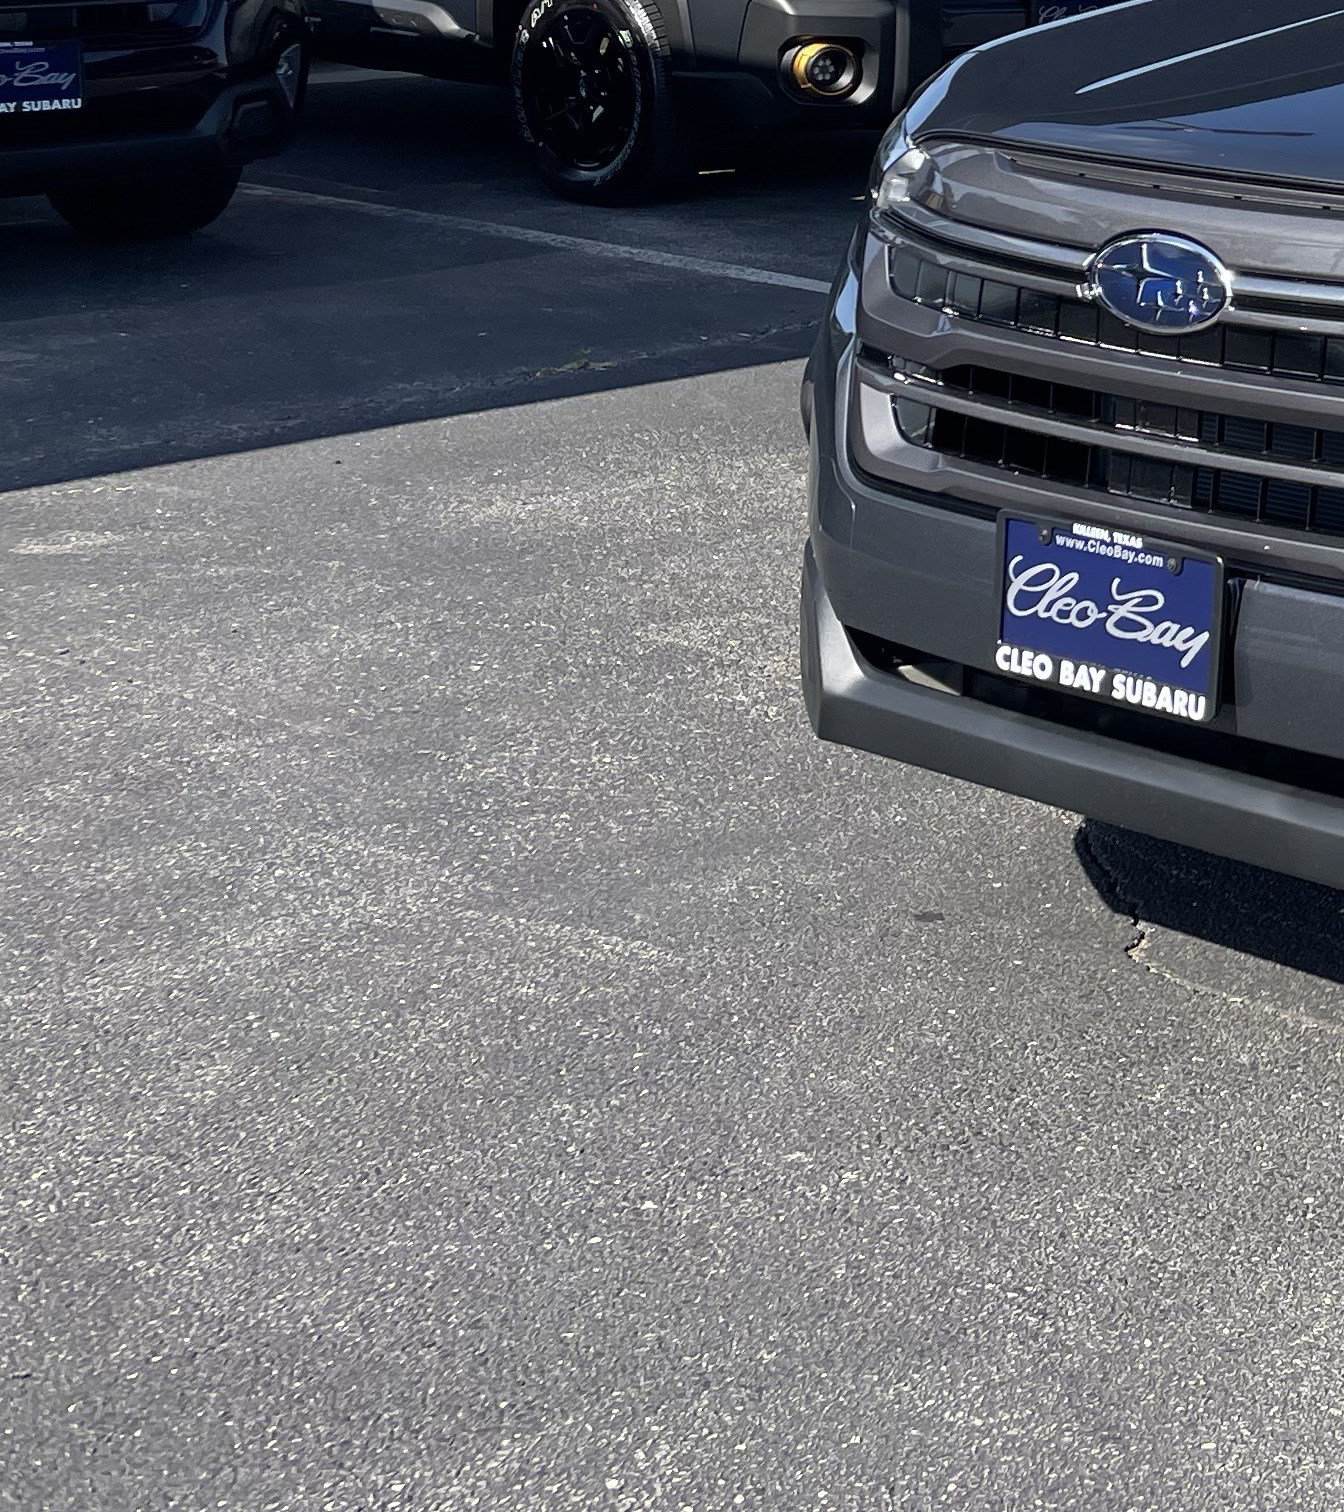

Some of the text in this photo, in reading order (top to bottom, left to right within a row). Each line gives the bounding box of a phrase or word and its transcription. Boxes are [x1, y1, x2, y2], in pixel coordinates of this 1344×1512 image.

[12, 61, 76, 90] Bay
[0, 98, 82, 113] AY SUBARU
[1055, 534, 1164, 568] www.CleoBay.com
[1112, 531, 1143, 549] TEXAS
[1007, 555, 1210, 669] Cleo Bay
[995, 645, 1206, 721] CLEO BAY SUBARU
